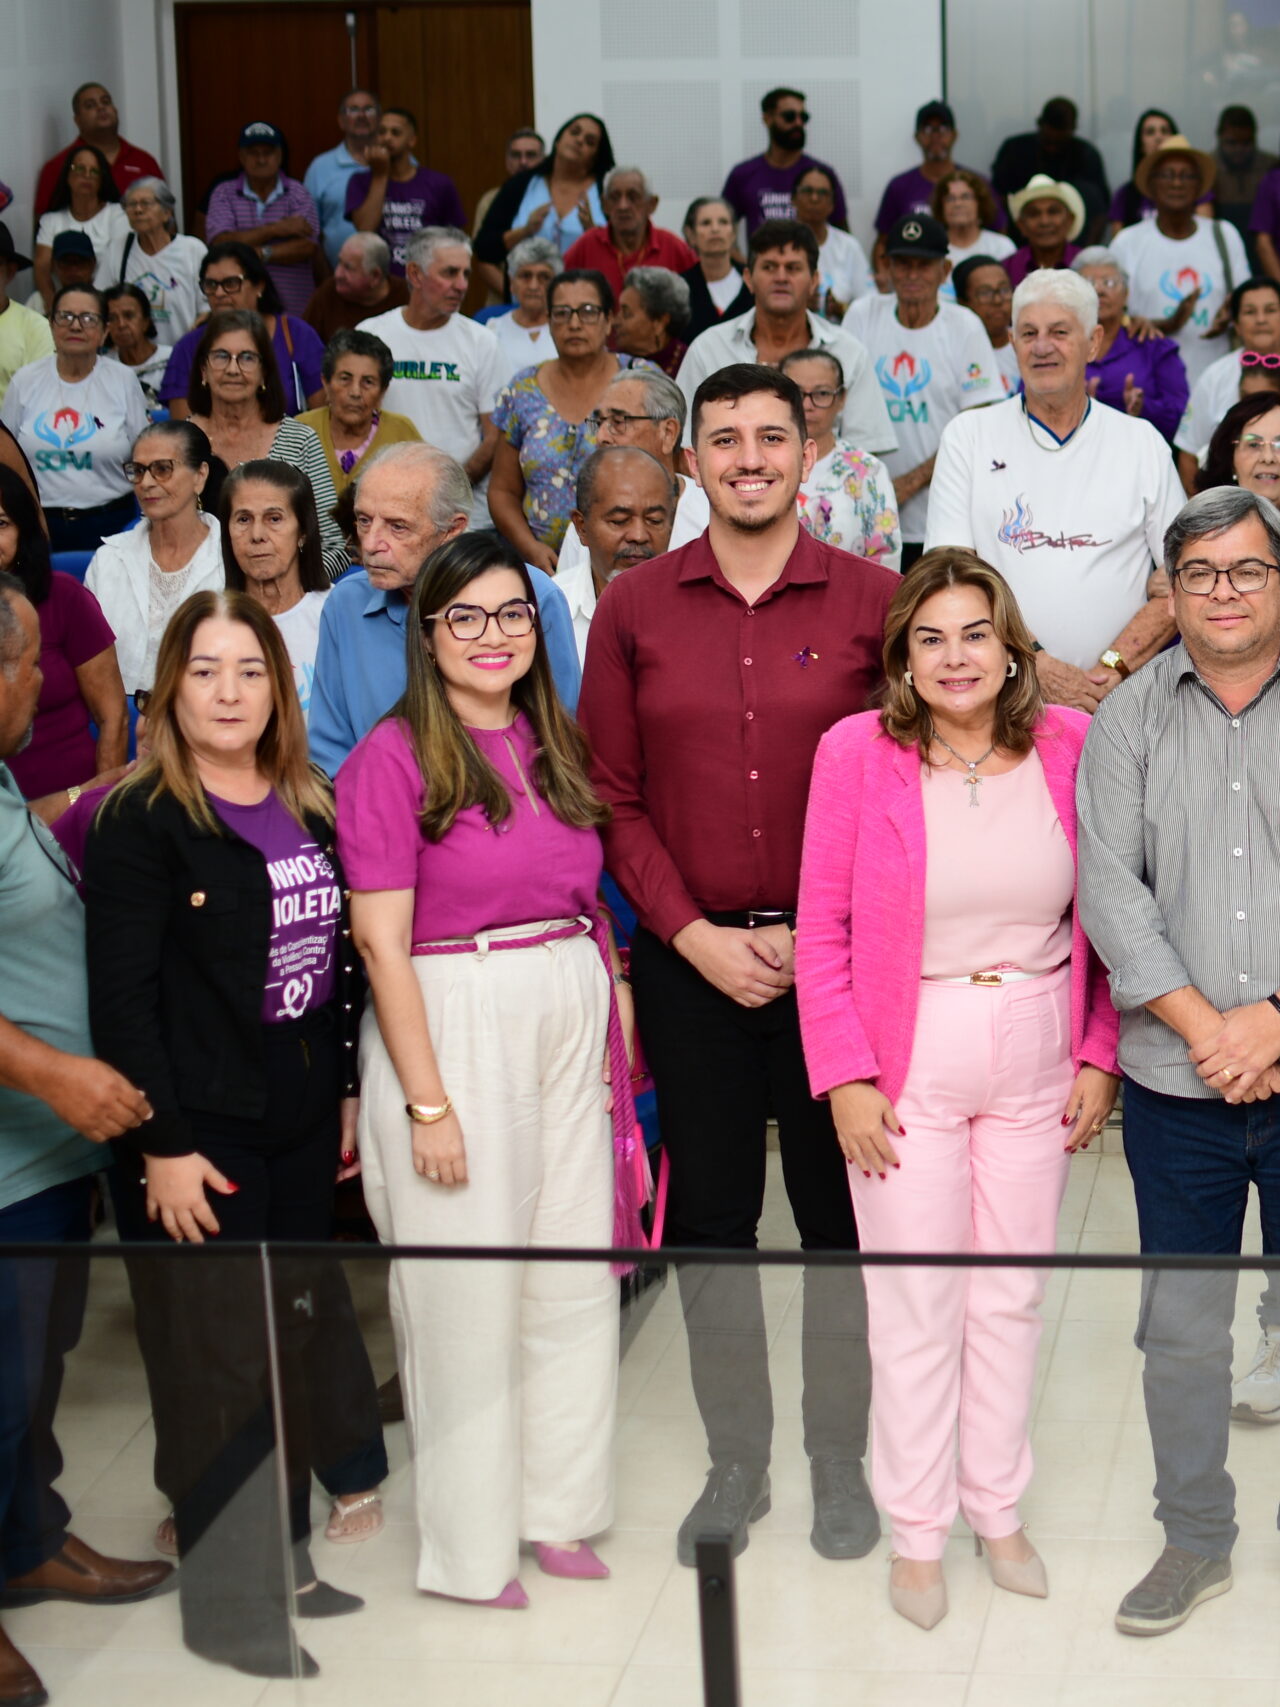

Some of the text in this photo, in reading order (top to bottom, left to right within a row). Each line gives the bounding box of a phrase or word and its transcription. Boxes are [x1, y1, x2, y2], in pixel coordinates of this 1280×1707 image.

[392, 361, 460, 381] URLEY.
[267, 855, 318, 891] NHO
[272, 886, 342, 928] IOLETA
